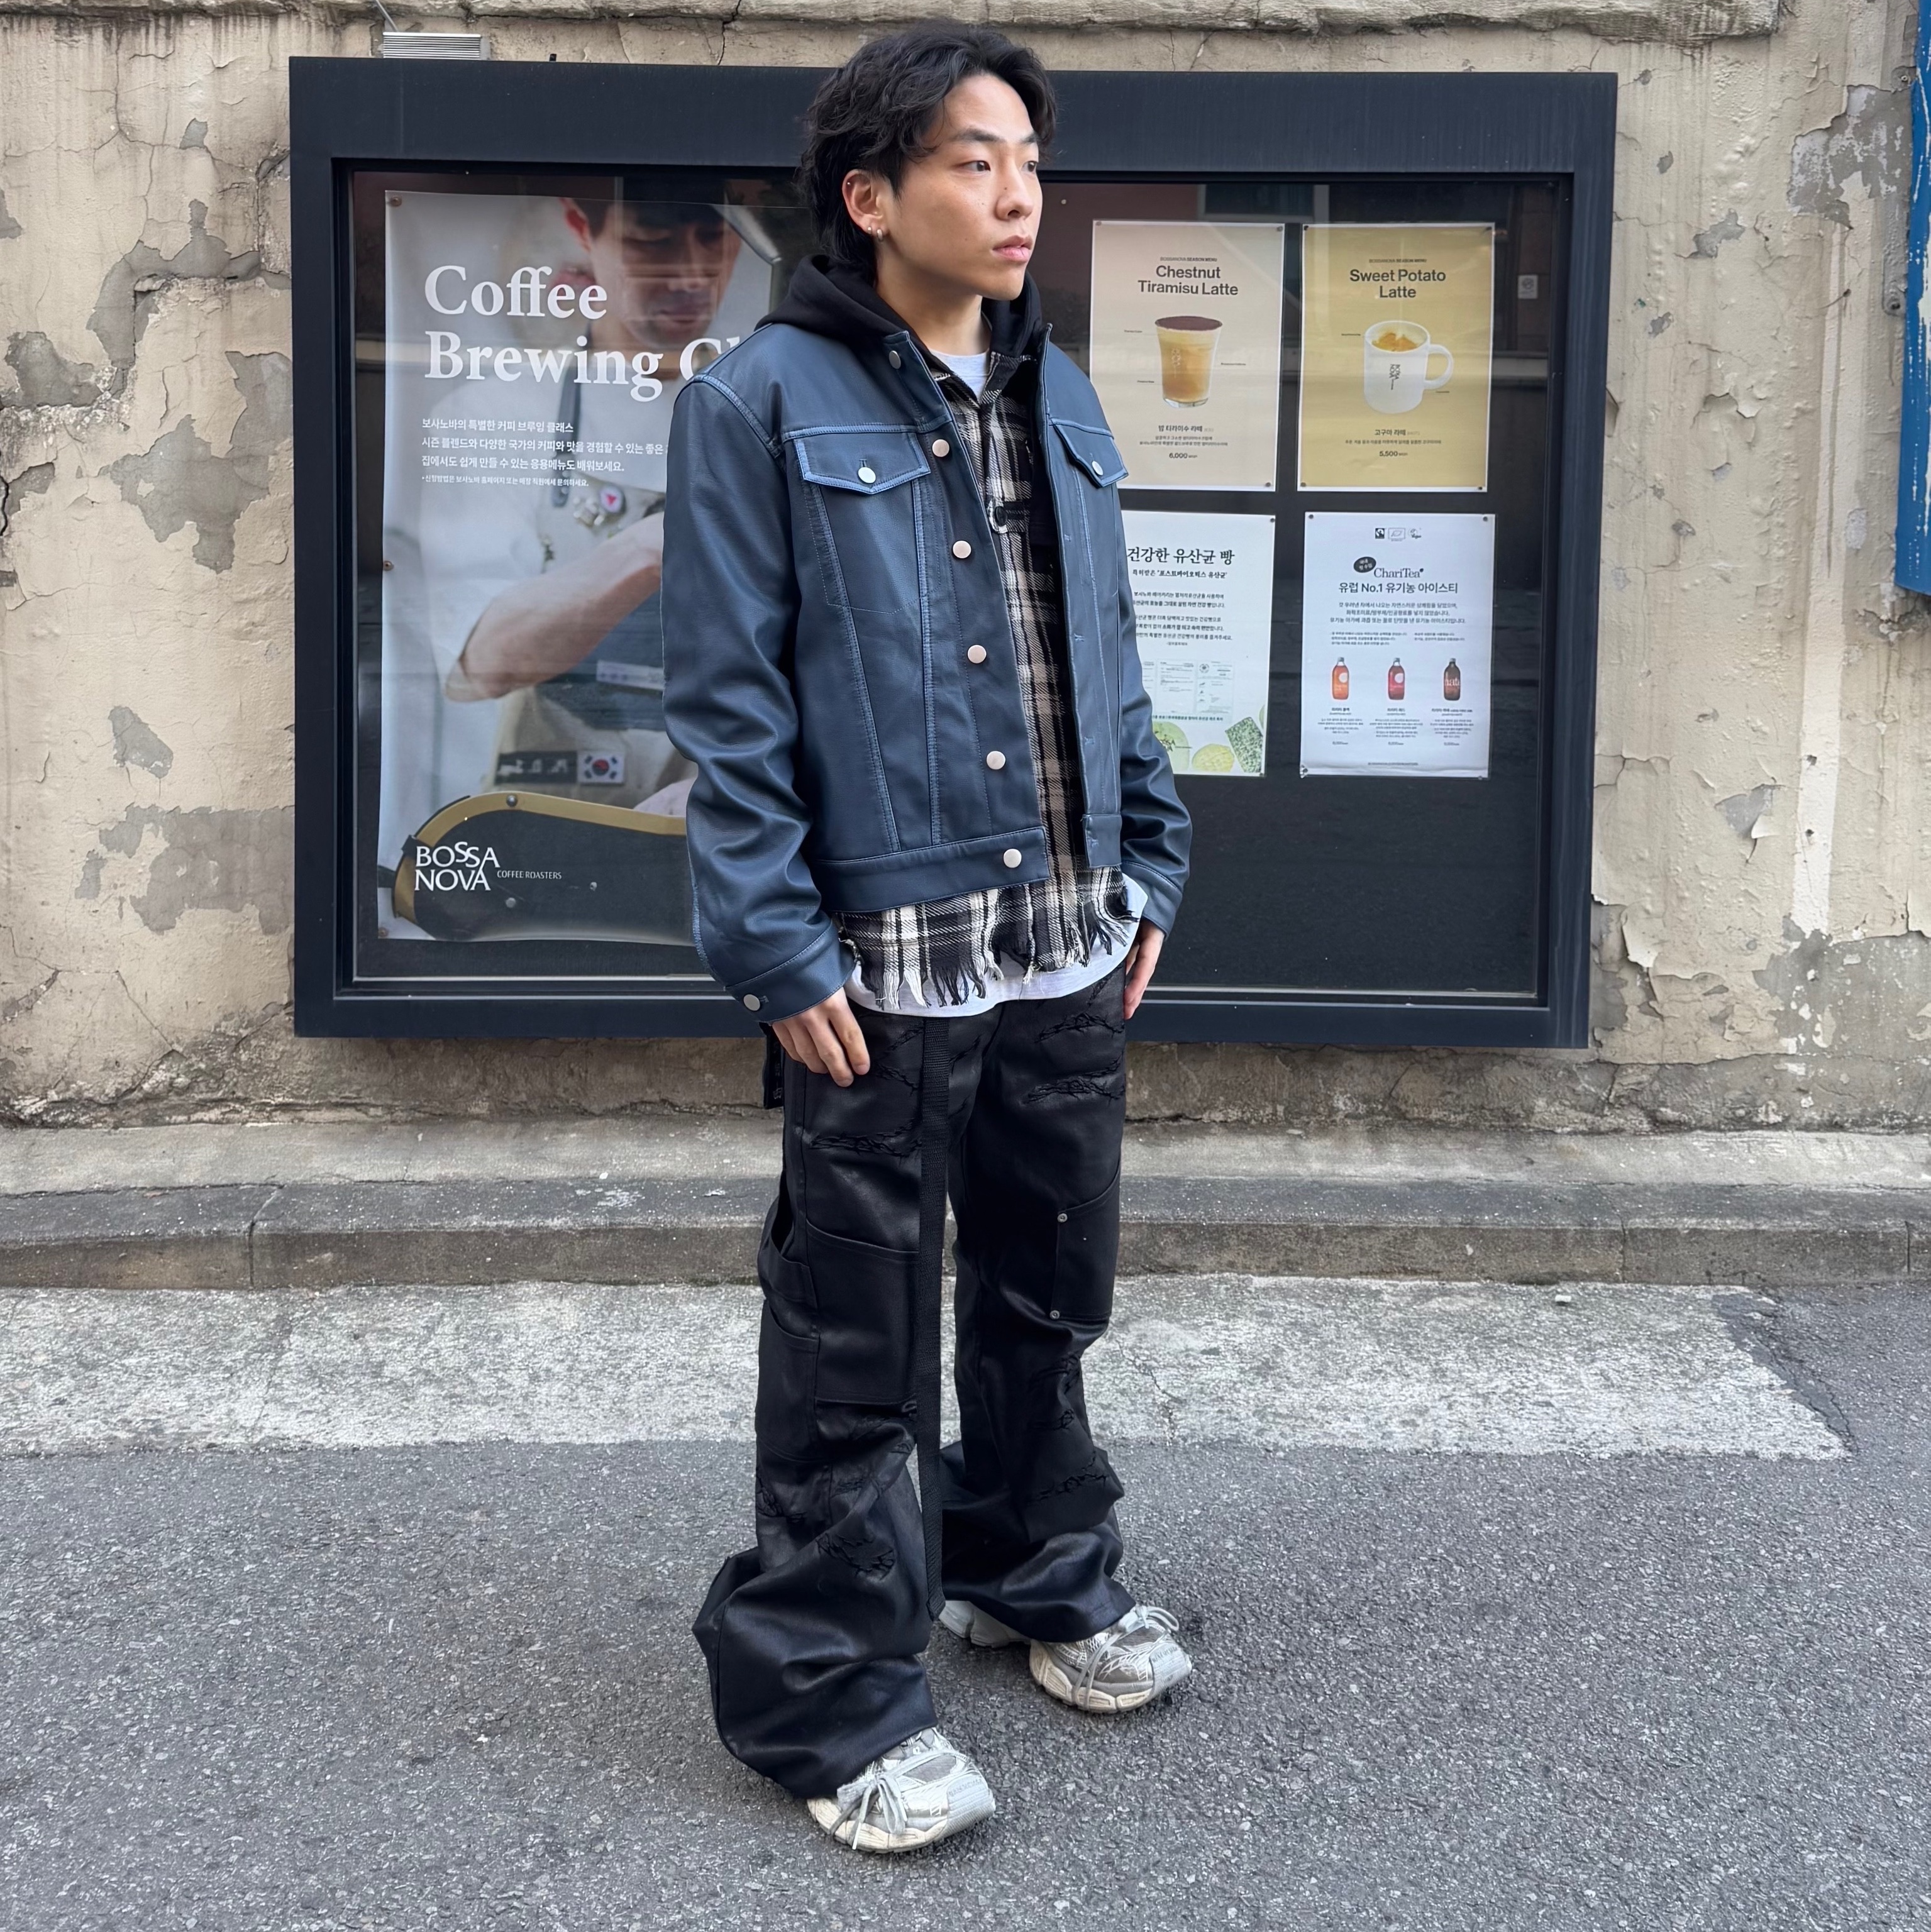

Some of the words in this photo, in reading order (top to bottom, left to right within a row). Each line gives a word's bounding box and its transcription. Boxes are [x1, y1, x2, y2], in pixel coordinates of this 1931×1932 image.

[1156, 265, 1221, 279] Chestnut
[1349, 269, 1395, 282] Sweet
[1398, 269, 1446, 282] Potato
[424, 265, 607, 319] Coffee
[1137, 280, 1199, 294] Tiramisu
[1202, 282, 1239, 295] Latte
[1380, 285, 1417, 298] Latte
[424, 331, 664, 402] Brewing
[422, 418, 467, 430] 보사노바의
[468, 419, 495, 431] 특별한
[497, 421, 516, 431] 커피
[517, 421, 545, 433] 브루잉
[546, 422, 574, 433] 클래스
[422, 437, 440, 448] 시즌
[441, 438, 478, 449] 블렌드와
[479, 438, 507, 450] 다양한
[509, 439, 536, 451] 국가의
[538, 440, 565, 451] 커피와
[567, 441, 584, 453] 맛을
[586, 441, 613, 453] 경험할
[615, 443, 624, 454] 수
[626, 443, 644, 454] 있는
[645, 443, 664, 455] 좋은
[422, 455, 458, 467] 집에서도
[460, 456, 477, 468] 쉽게
[479, 457, 498, 468] 만들
[499, 458, 509, 469] 수
[511, 458, 529, 469] 있는
[531, 458, 576, 471] 응용메뉴도
[577, 460, 624, 472] 배워보세요.
[456, 475, 480, 483] 보사노바
[481, 476, 505, 485] 홈페이지
[557, 478, 589, 487] 문의하세요.
[1127, 546, 1170, 563] 건강한
[1173, 548, 1215, 565] 유산균
[1220, 549, 1235, 565] 빵
[1374, 568, 1421, 578] ChariTea
[1339, 582, 1358, 593] 유럽
[1361, 583, 1383, 593] No.1
[1385, 582, 1415, 594] 유기농
[1418, 582, 1458, 594] 아이스티
[416, 841, 501, 868] BOSSA
[414, 869, 492, 891] NOVA
[497, 869, 524, 879] COFFEE
[525, 870, 563, 880] ROASTERS
